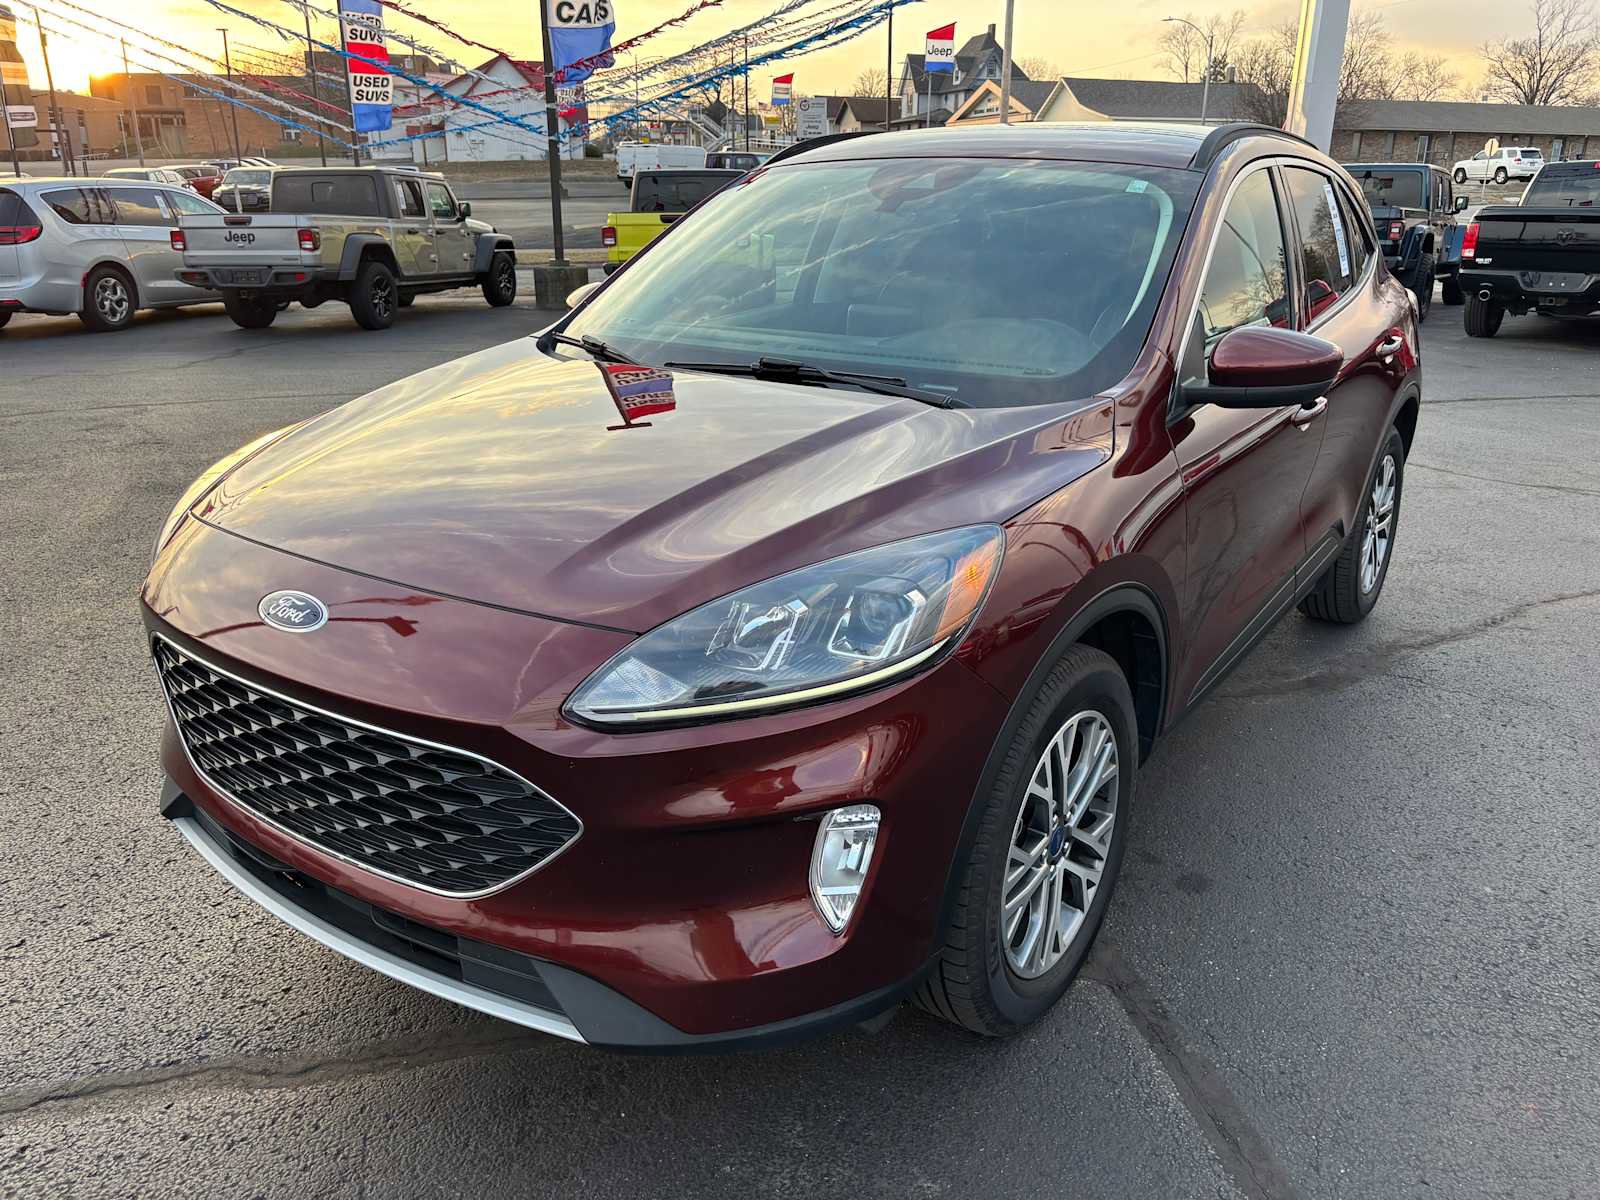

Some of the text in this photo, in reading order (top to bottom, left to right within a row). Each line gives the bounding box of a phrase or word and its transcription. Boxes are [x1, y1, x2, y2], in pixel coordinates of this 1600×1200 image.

[349, 28, 383, 43] SUVS
[927, 44, 953, 57] Jeep
[353, 75, 390, 88] USED
[355, 89, 390, 102] SUVS
[224, 230, 256, 244] Jeep
[268, 596, 311, 624] Ford
